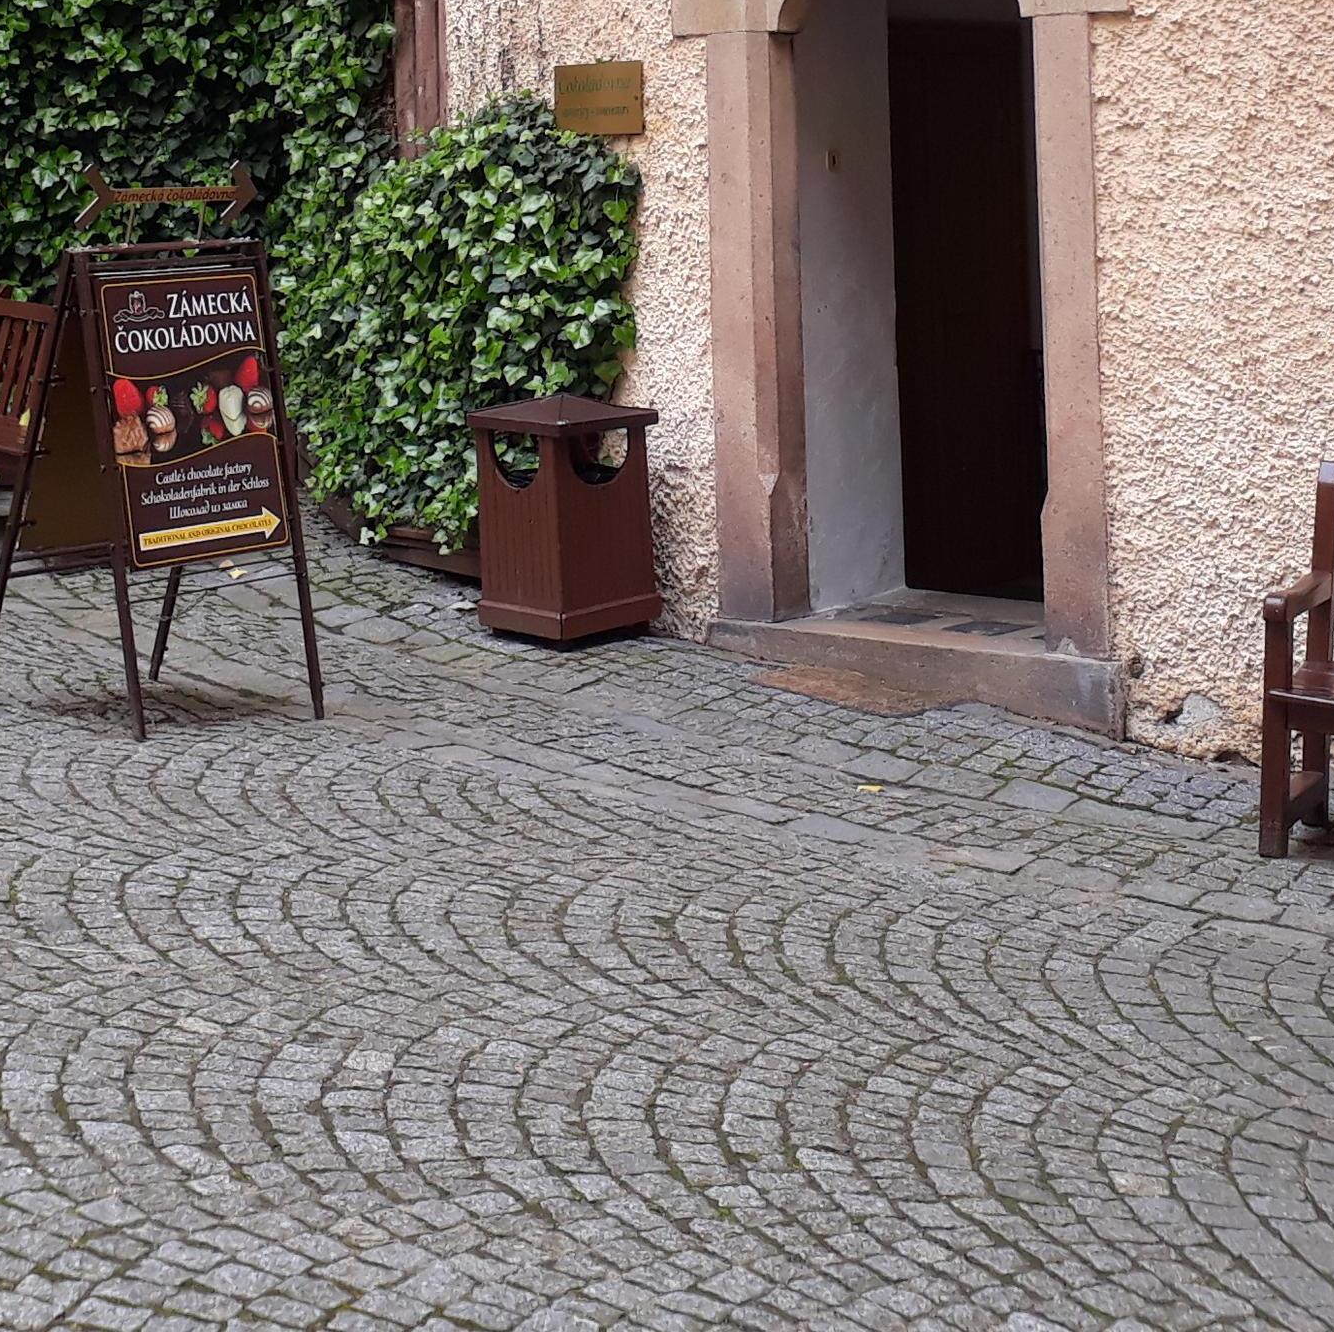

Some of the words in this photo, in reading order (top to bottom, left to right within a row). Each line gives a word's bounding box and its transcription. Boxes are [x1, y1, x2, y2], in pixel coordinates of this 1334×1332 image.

[167, 286, 253, 318] ZÁMECKÁ
[115, 320, 256, 353] ČOKOLÁDOVNA
[156, 469, 186, 485] Castle's
[187, 465, 223, 480] chocolate
[224, 463, 252, 480] factory
[141, 483, 217, 506] Schokoladenfabrik
[218, 484, 226, 493] in
[228, 479, 242, 492] der
[242, 476, 269, 490] Schloss
[169, 500, 210, 519] Шоколад
[143, 531, 186, 546] TRADITIONAL
[187, 529, 201, 539] AND
